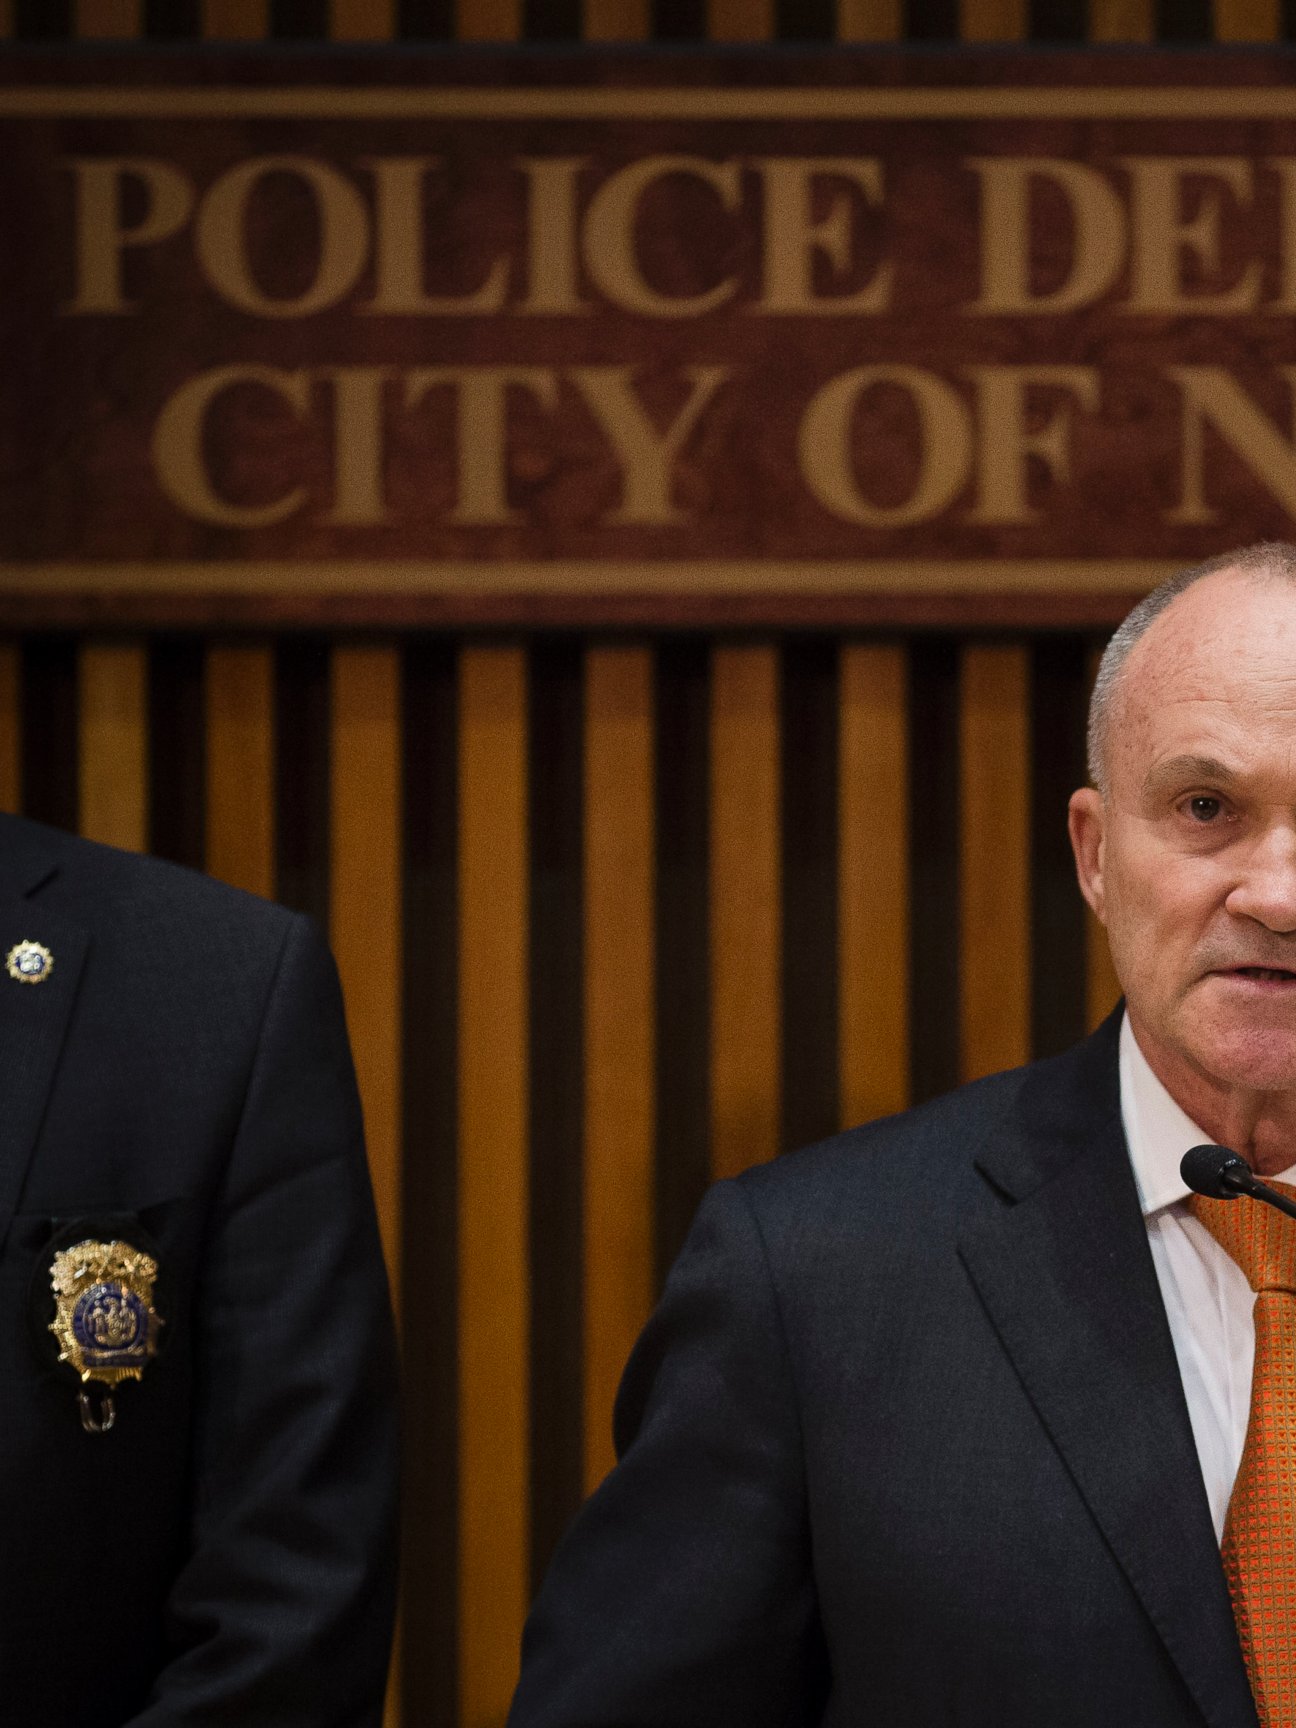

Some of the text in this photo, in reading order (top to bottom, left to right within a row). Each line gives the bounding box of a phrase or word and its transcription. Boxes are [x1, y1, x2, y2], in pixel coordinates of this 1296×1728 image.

[68, 154, 894, 316] POLICE
[151, 363, 730, 527] CITY
[799, 363, 1100, 526] OF
